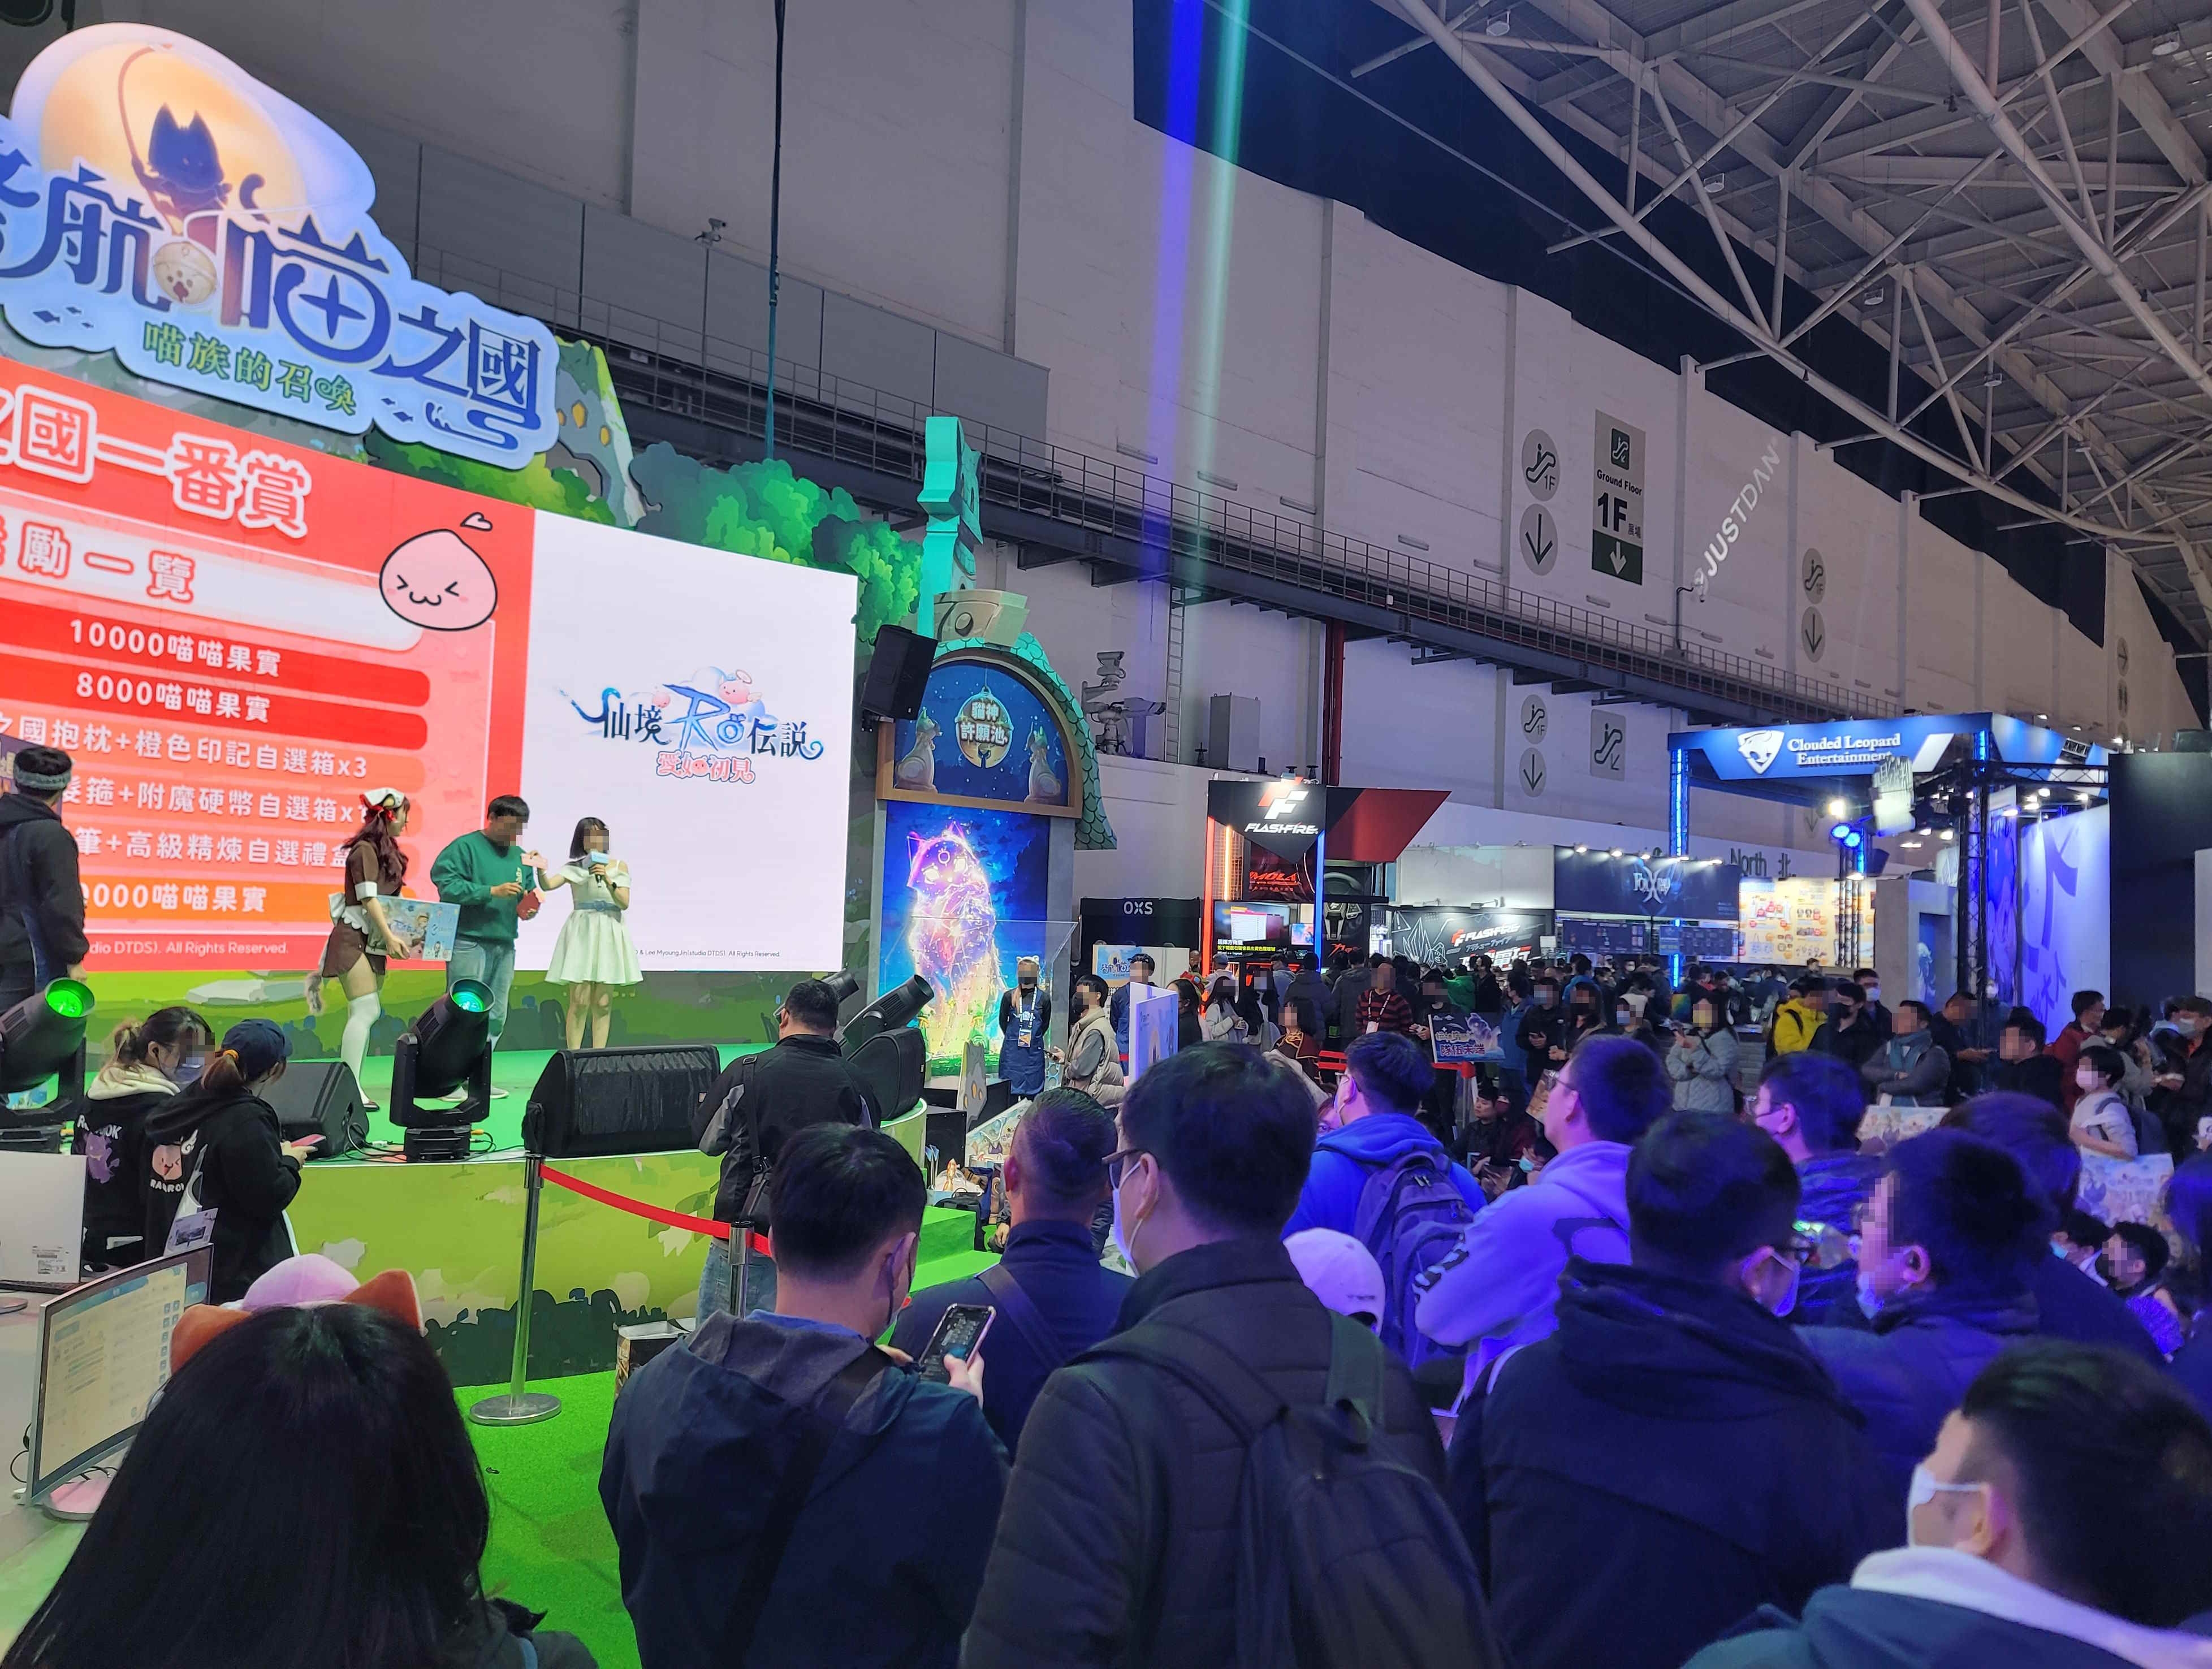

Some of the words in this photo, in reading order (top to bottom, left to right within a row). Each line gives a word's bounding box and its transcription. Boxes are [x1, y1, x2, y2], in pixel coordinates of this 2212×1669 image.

[143, 321, 357, 416] 喵族的召喚
[1544, 474, 1556, 490] 1F
[1597, 469, 1622, 487] Ground
[1625, 481, 1642, 495] Floor
[1598, 492, 1627, 532] 1F
[0, 516, 195, 604] 勵一覽
[71, 619, 282, 678] 10000喵喵果實
[76, 672, 271, 724] 8000喵喵果實
[1536, 725, 1545, 736] 1F
[1787, 736, 1842, 752] Clouded
[1844, 733, 1901, 751] Leopard
[1731, 849, 1767, 876] North
[1124, 901, 1153, 915] OXS
[166, 941, 182, 954] All
[185, 941, 224, 957] Rights
[228, 941, 288, 955] Reserved.
